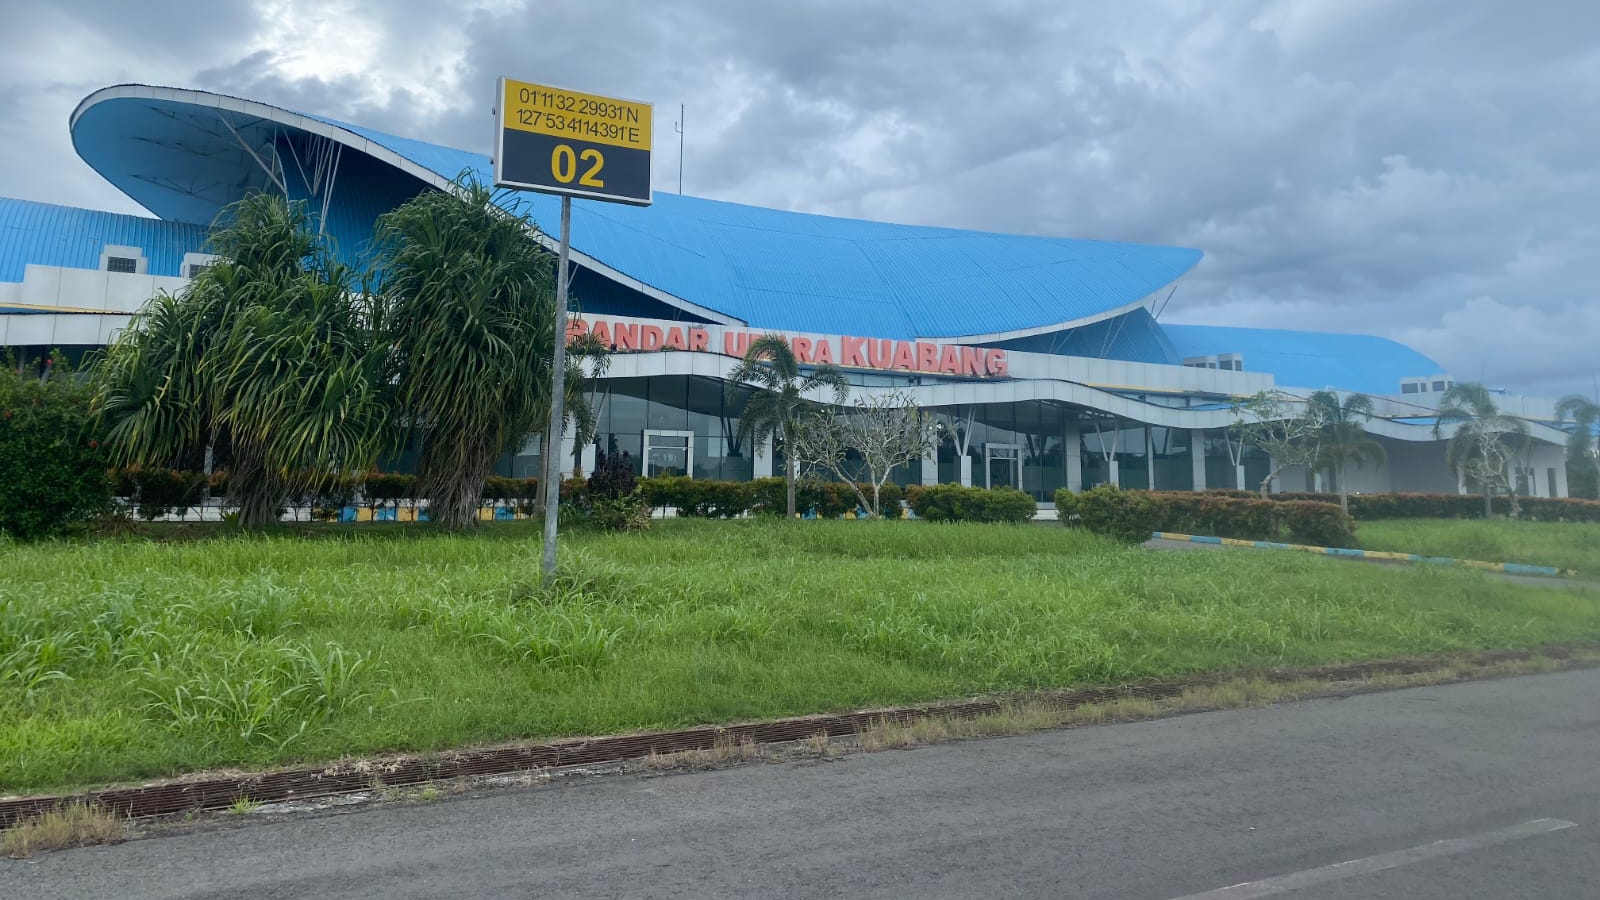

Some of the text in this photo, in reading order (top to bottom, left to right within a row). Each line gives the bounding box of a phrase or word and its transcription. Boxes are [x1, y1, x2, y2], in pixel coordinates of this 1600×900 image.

[551, 144, 605, 188] 02
[724, 331, 834, 364] URA
[842, 335, 1008, 377] KUABANG
